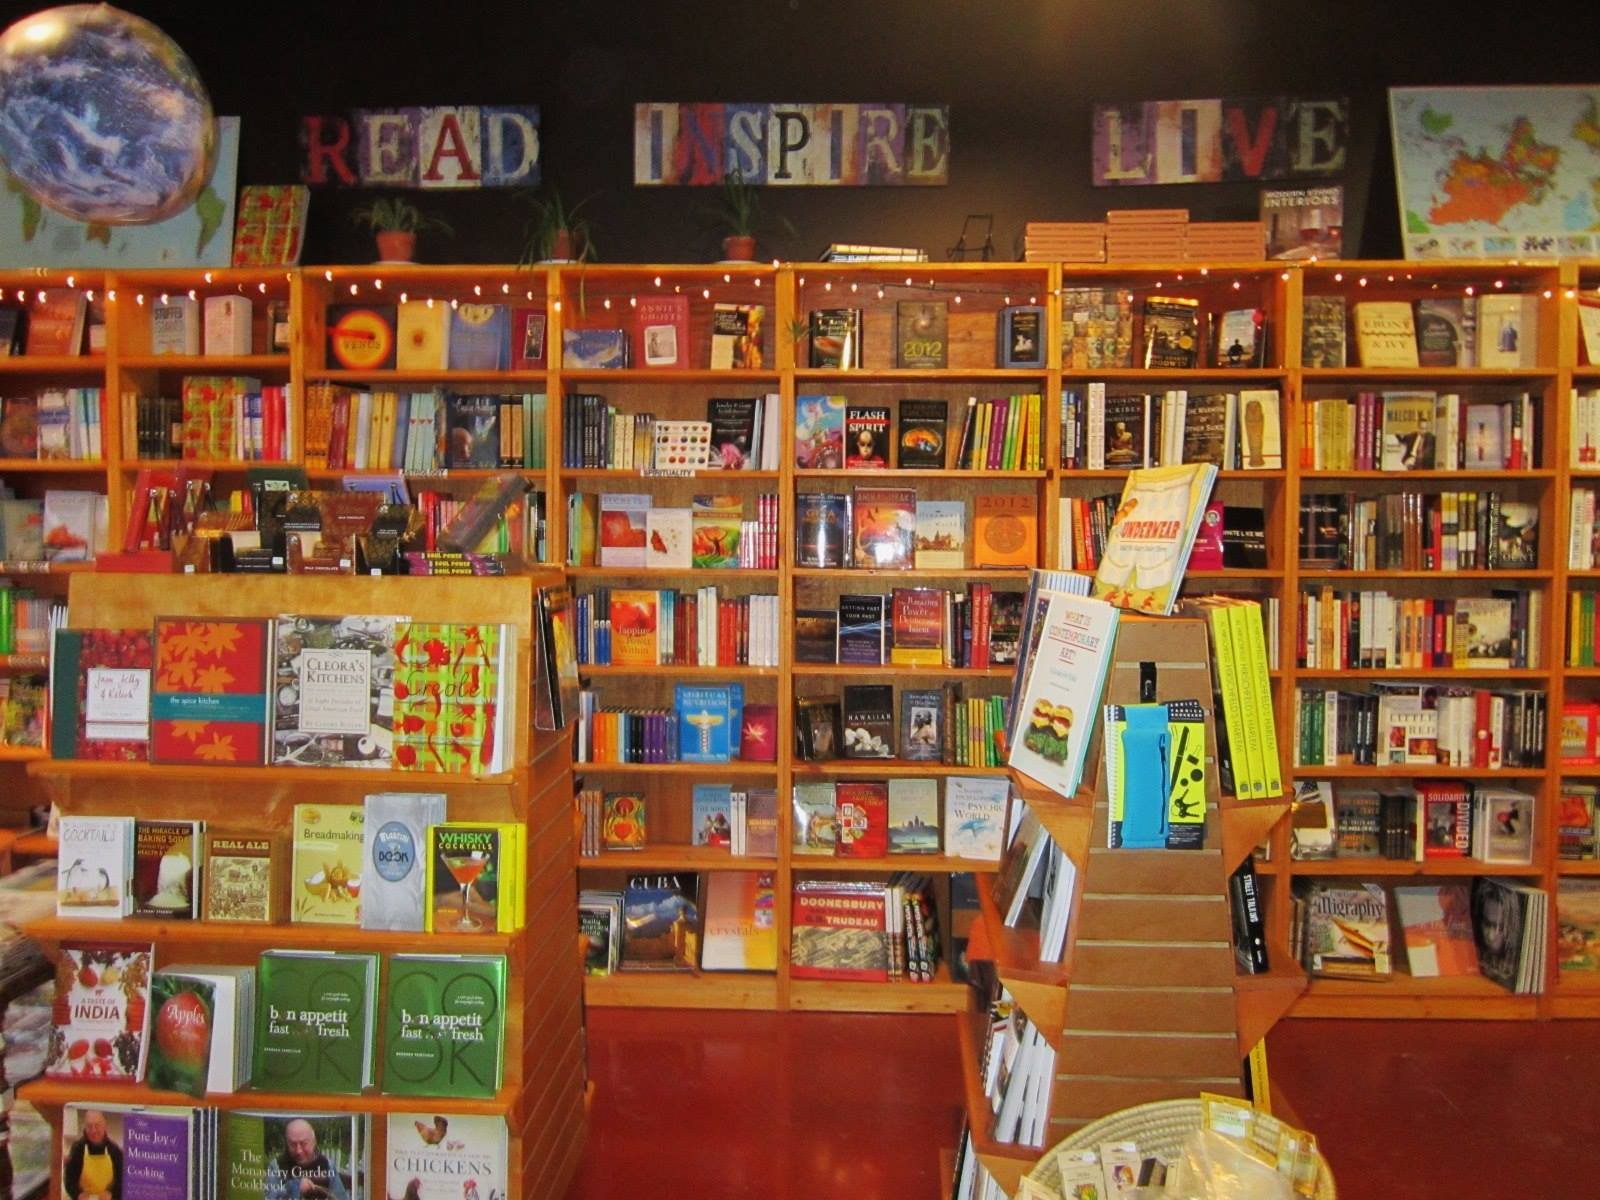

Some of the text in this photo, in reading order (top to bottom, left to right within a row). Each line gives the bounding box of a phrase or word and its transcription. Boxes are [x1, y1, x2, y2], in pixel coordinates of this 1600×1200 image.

[304, 110, 541, 185] READ
[642, 103, 948, 183] INSPIRE
[1100, 100, 1346, 180] LIVE
[903, 341, 943, 357] 2012
[849, 410, 886, 420] FLASH
[848, 423, 886, 432] SPIRIT
[982, 496, 1031, 508] 2012
[1120, 520, 1181, 539] UNDERWEAR
[306, 657, 365, 672] CLEORA'S
[306, 671, 365, 684] KITCHENS
[405, 669, 481, 698] Creole
[170, 696, 220, 707] the spice kitchen
[848, 713, 891, 721] HAWAIIAN
[1427, 792, 1471, 802] SOLIDARITY
[954, 810, 990, 821] WORLD
[138, 826, 150, 834] THE
[151, 826, 179, 834] MIRACLE
[1455, 802, 1470, 849] DIVIDED
[63, 829, 116, 842] COCKTAILS
[138, 834, 167, 843] BAKING
[304, 829, 365, 843] Breadmaking
[438, 832, 493, 843] WHISKY
[213, 839, 270, 850] REAL ALE
[438, 842, 493, 850] COCKTAILS
[629, 874, 682, 890] CUBA
[800, 896, 884, 910] DOONESBURY
[825, 915, 878, 927] TRUDEAU
[74, 1005, 121, 1020] INDIA
[167, 1003, 206, 1026] Apples
[268, 1022, 349, 1038] fast fresh
[401, 1024, 484, 1041] fast fresh
[128, 1128, 151, 1142] Pure
[152, 1130, 169, 1145] Joy
[128, 1146, 180, 1163] Monastery
[239, 1149, 262, 1163] The
[127, 1164, 166, 1180] Cooking
[232, 1161, 336, 1179] Monastery Garden
[393, 1157, 493, 1176] CHICKENS
[231, 1177, 288, 1193] Cookbook
